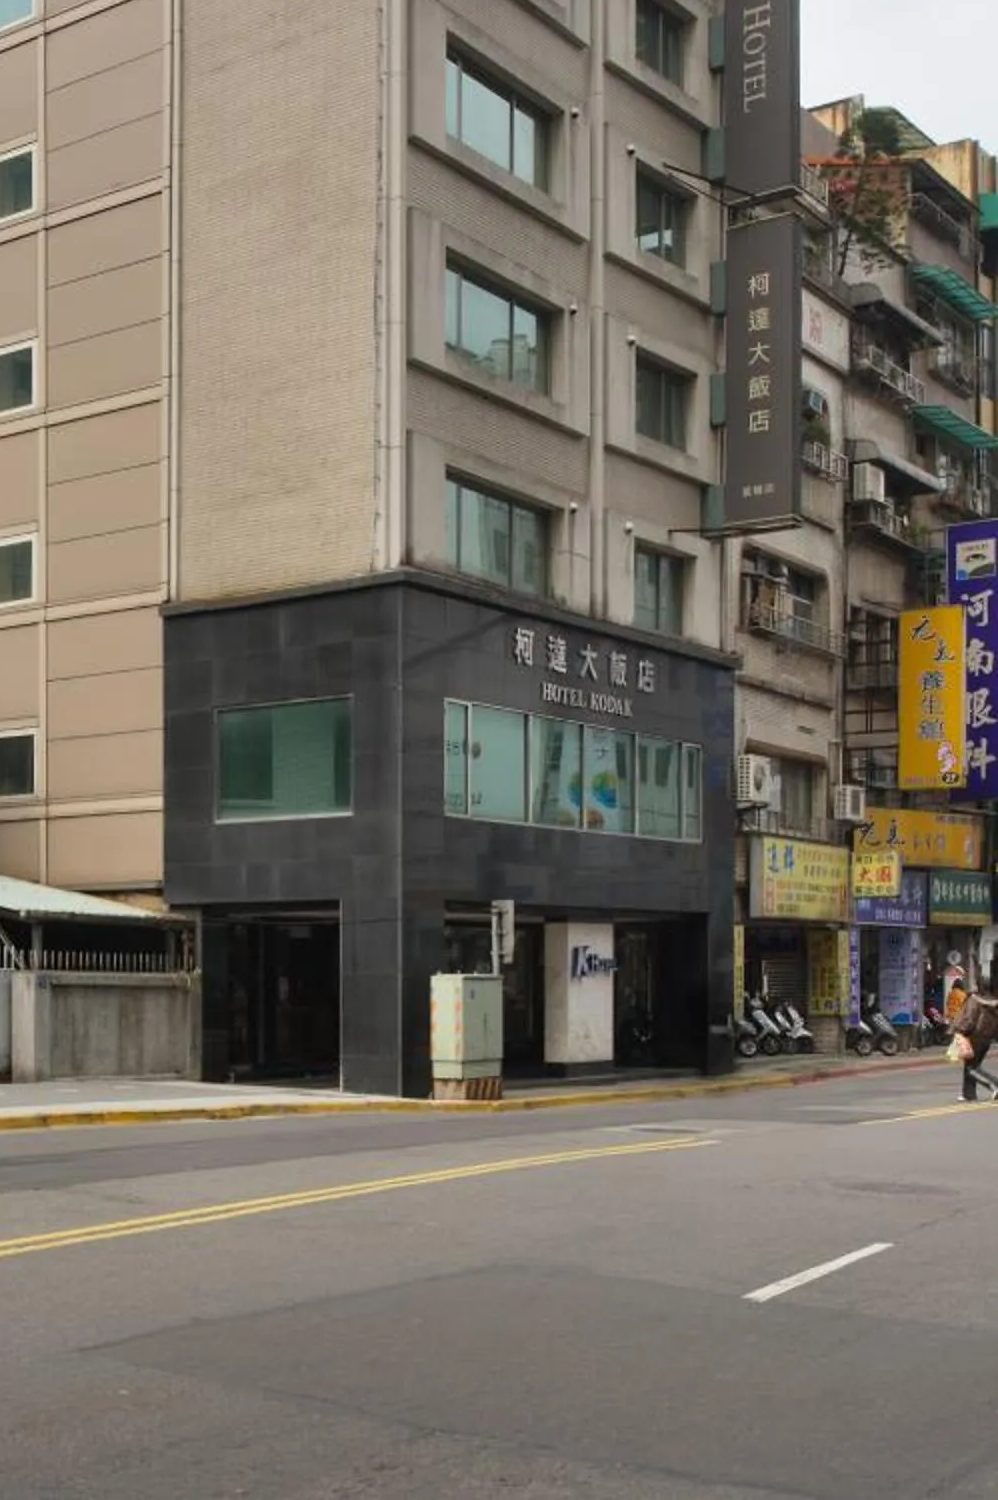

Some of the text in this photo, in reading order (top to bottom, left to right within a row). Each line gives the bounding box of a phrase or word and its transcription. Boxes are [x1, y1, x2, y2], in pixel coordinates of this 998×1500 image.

[743, 1, 771, 113] HOTEL
[747, 273, 770, 433] 柯達大飯店
[514, 627, 655, 693] 柯達大飯店
[542, 682, 633, 717] HOTEL KODAK
